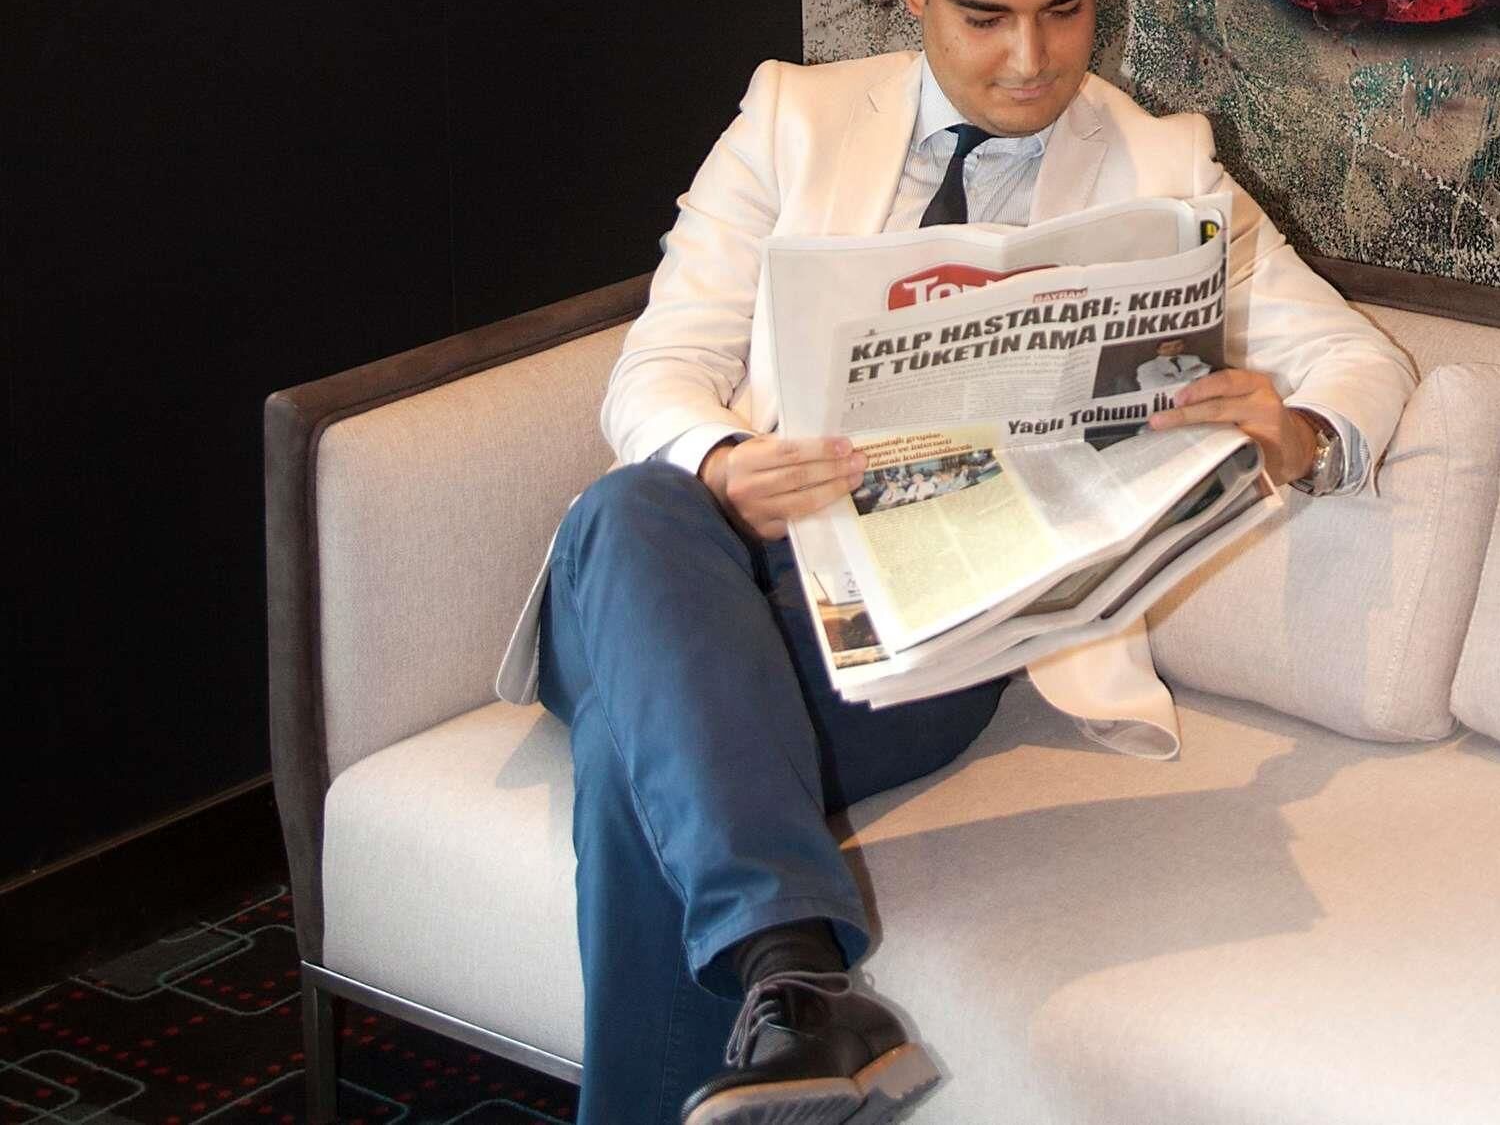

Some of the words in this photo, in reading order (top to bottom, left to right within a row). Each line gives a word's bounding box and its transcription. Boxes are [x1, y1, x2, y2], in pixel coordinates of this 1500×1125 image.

[848, 362, 884, 383] ET
[890, 334, 1022, 375] TÜKETİN
[1026, 324, 1097, 351] AMA
[850, 331, 932, 363] KALP
[939, 296, 1121, 345] HASTALARI;
[1008, 417, 1064, 435] Yağlı
[1069, 403, 1148, 426] Tohum
